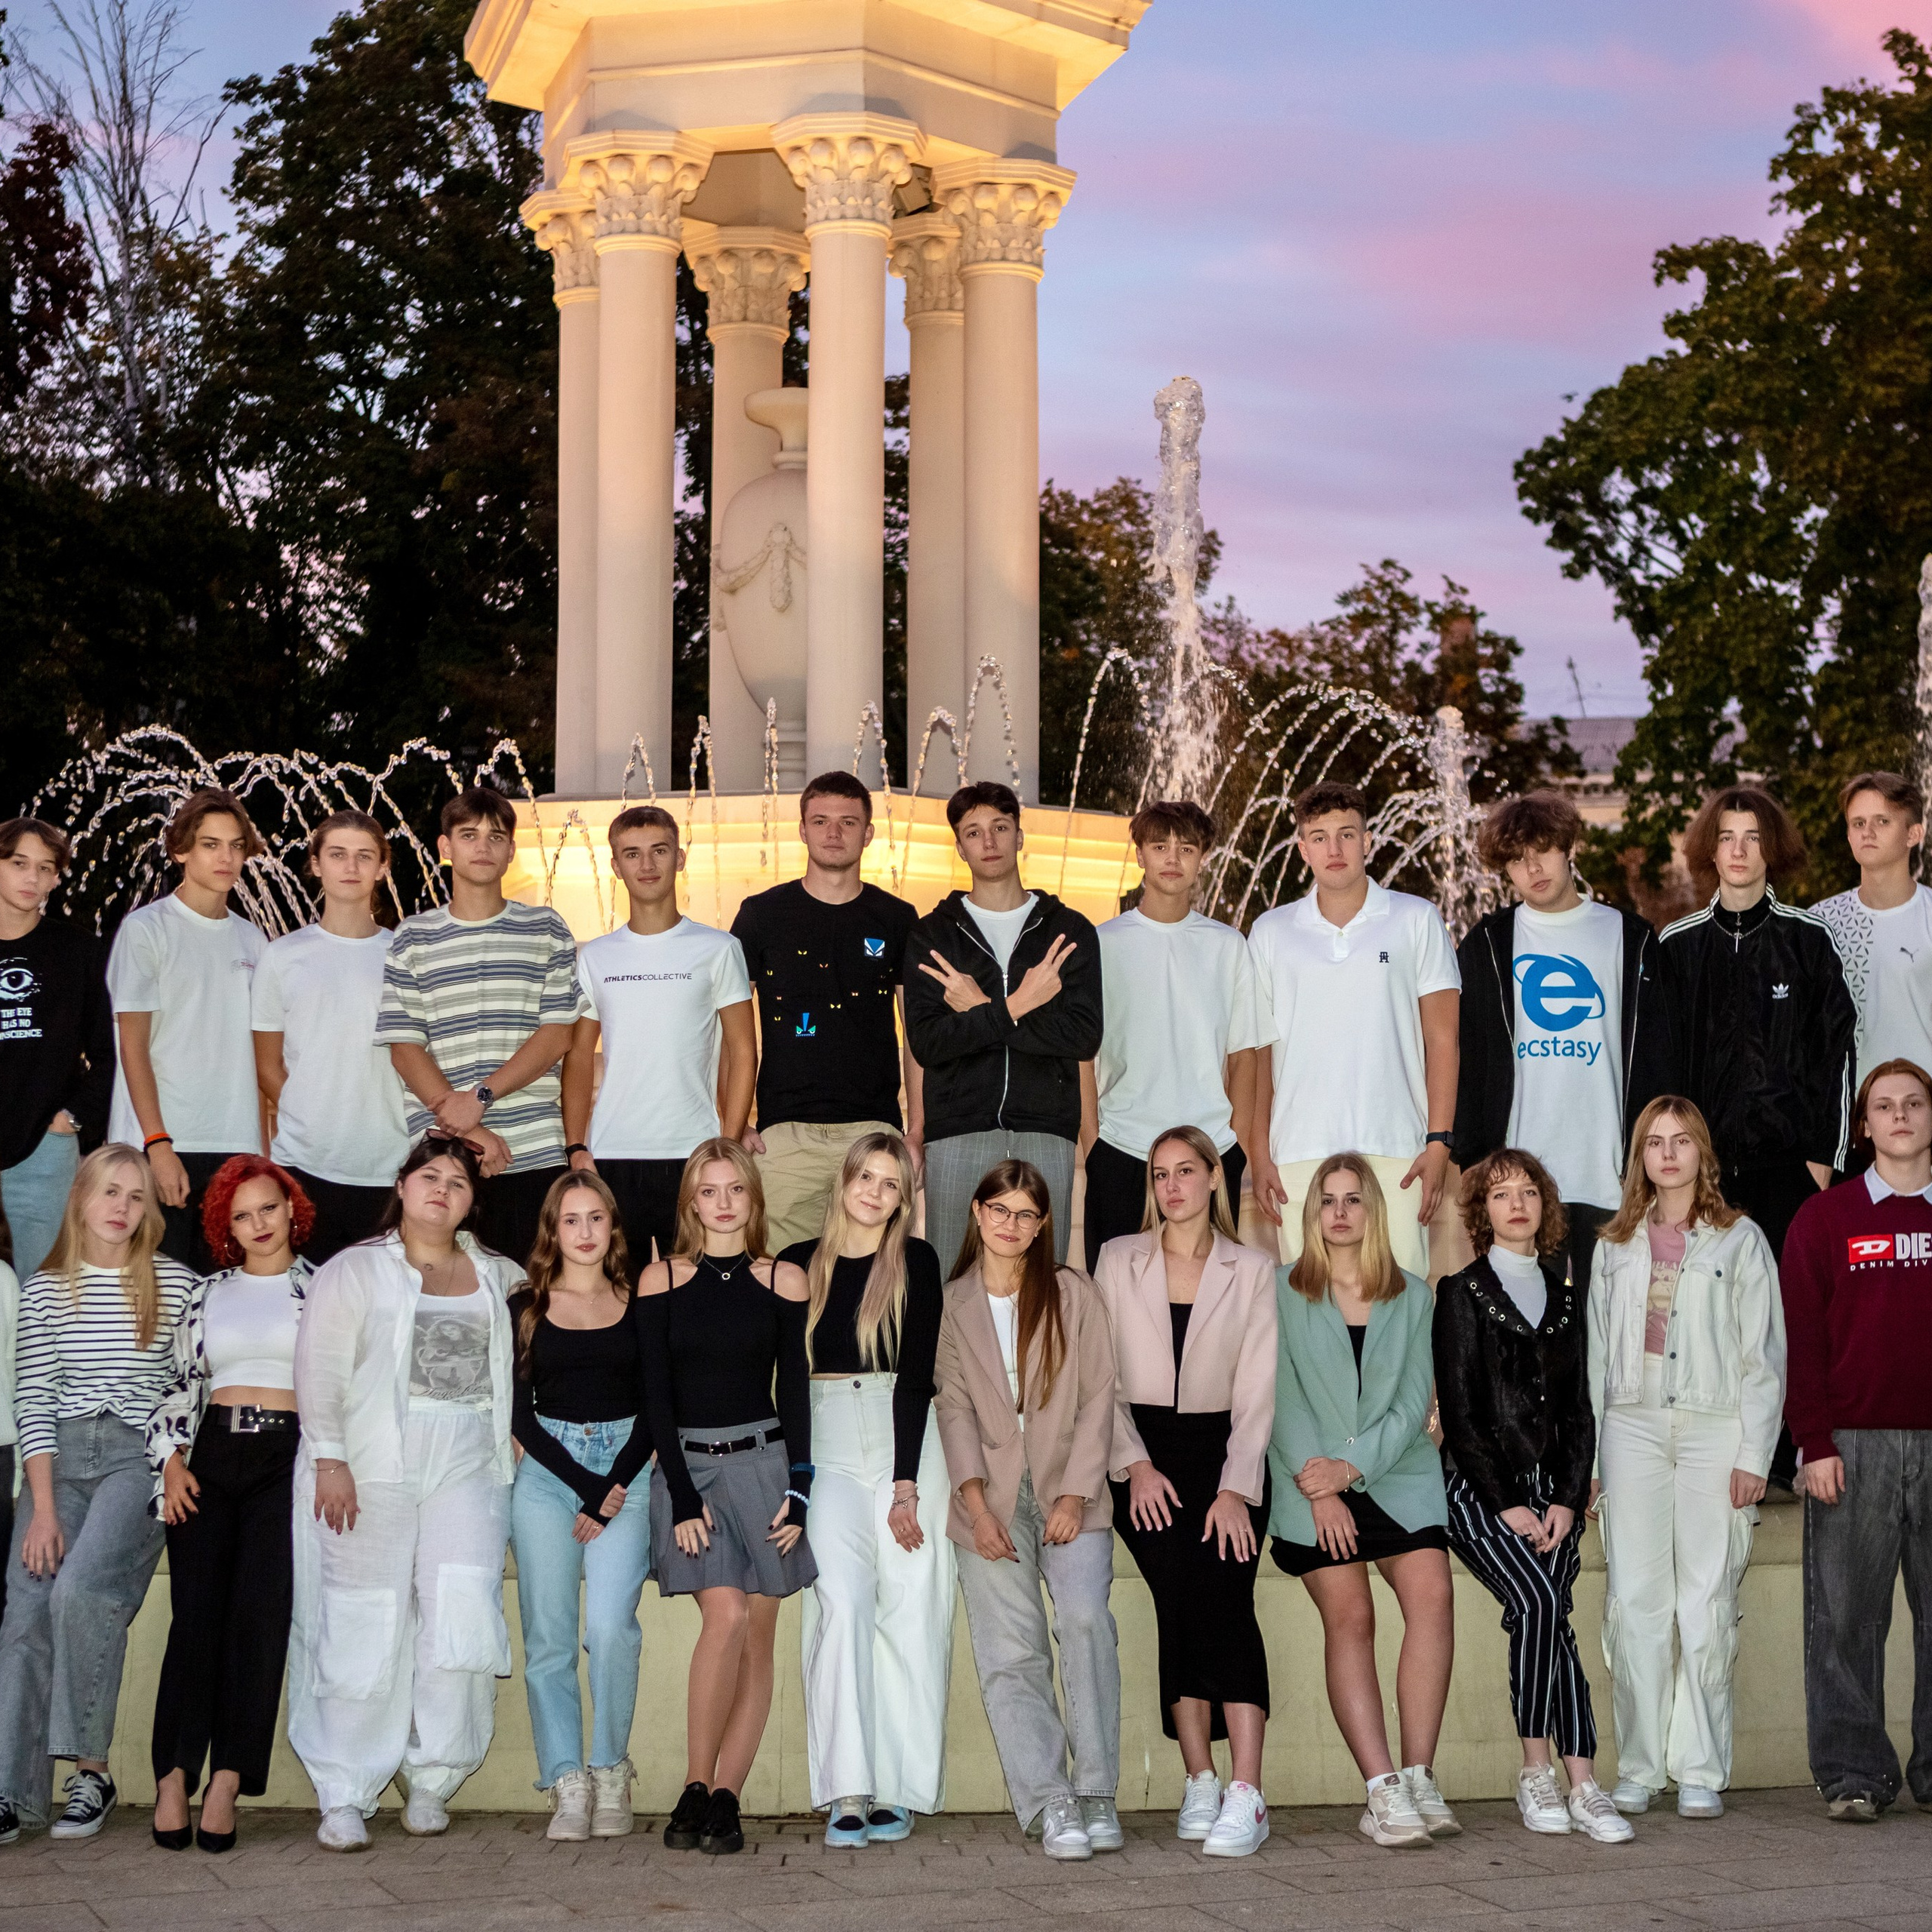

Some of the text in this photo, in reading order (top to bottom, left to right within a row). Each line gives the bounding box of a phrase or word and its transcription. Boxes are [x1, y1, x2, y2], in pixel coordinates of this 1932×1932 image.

[0, 1007, 32, 1018] THE EYE
[2, 1019, 31, 1029] HAS NO
[1518, 1036, 1601, 1066] ecstasy
[1895, 1232, 1932, 1260] DIE
[1850, 1260, 1894, 1272] DENIM
